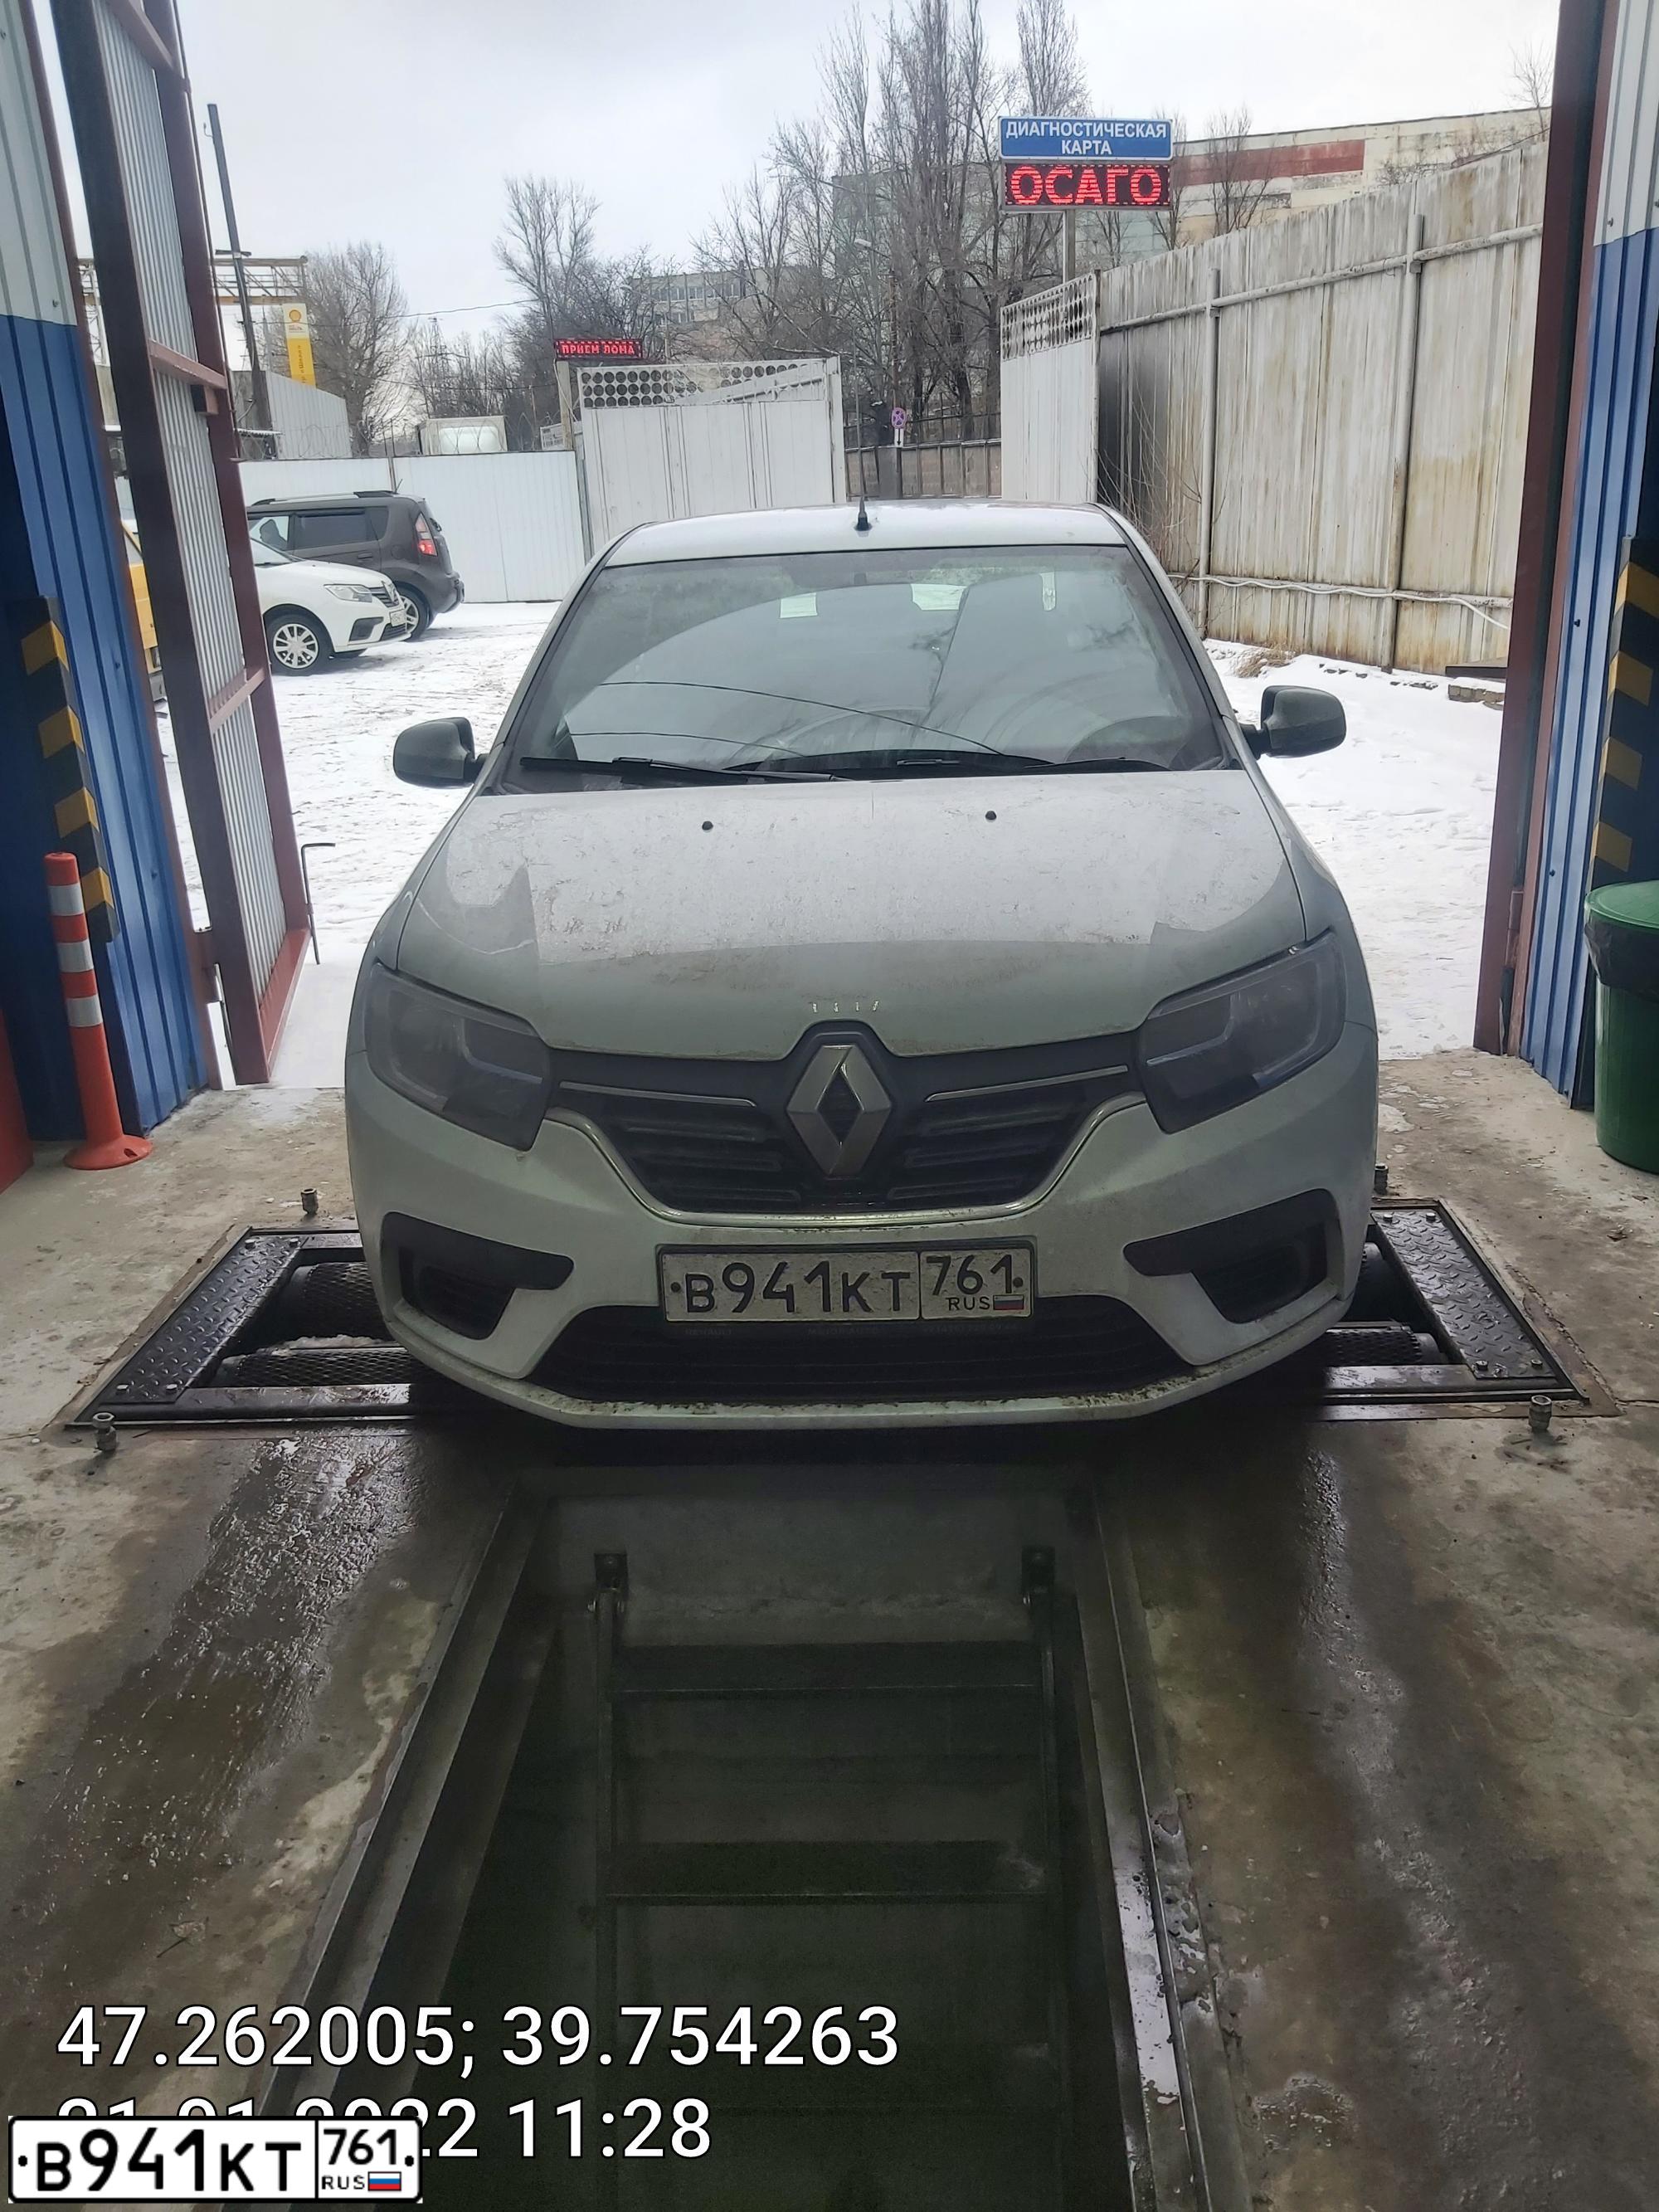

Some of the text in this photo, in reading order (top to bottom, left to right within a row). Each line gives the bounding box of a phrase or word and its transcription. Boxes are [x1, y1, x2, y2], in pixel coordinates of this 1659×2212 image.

[1005, 120, 1167, 139] ДИАГНОСТИЧЕСКАЯ
[1061, 139, 1112, 155] КАРТА
[1010, 165, 1161, 205] ОСАГО
[562, 344, 600, 353] ПРИЕМ
[684, 1255, 1013, 1313] В941КТ 761
[947, 1297, 990, 1311] RUS
